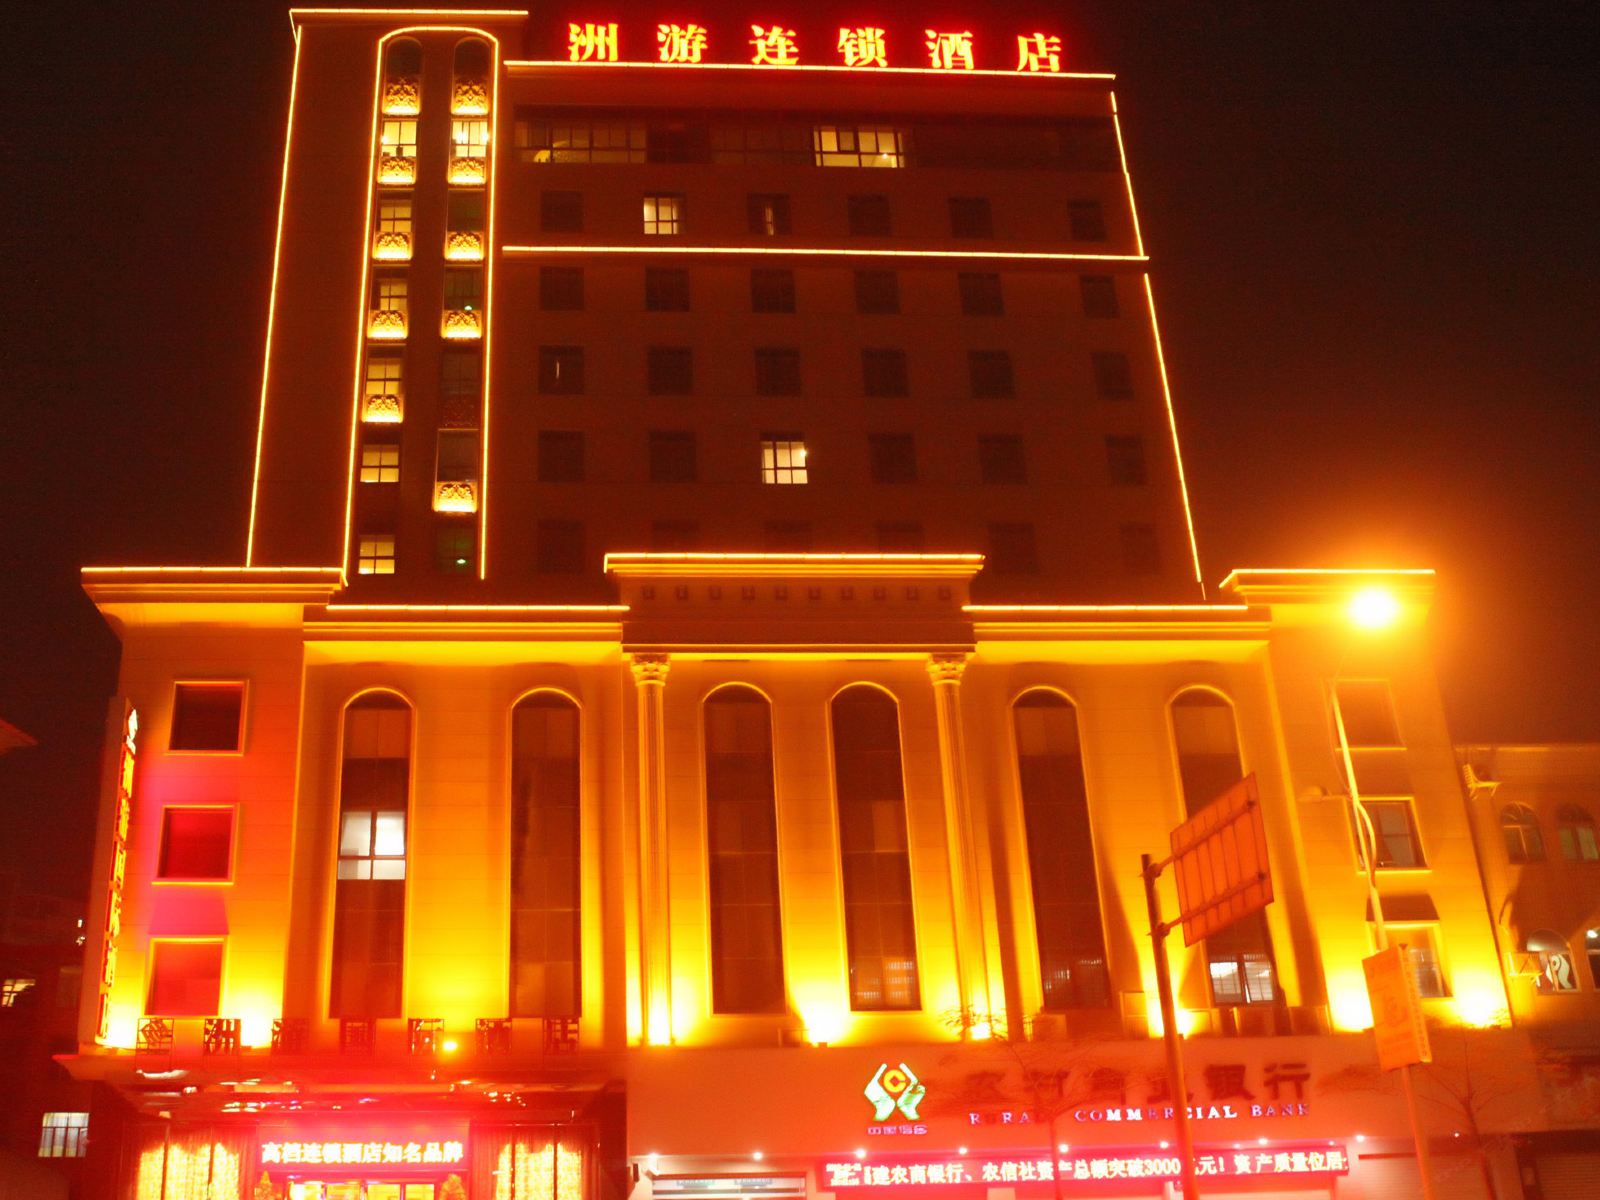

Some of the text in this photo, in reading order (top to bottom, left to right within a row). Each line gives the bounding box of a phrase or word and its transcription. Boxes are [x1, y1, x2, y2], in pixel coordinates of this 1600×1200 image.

[568, 23, 1061, 73] 洲游连锁酒店
[969, 1111, 1045, 1125] RRA
[1251, 1104, 1310, 1118] BANK
